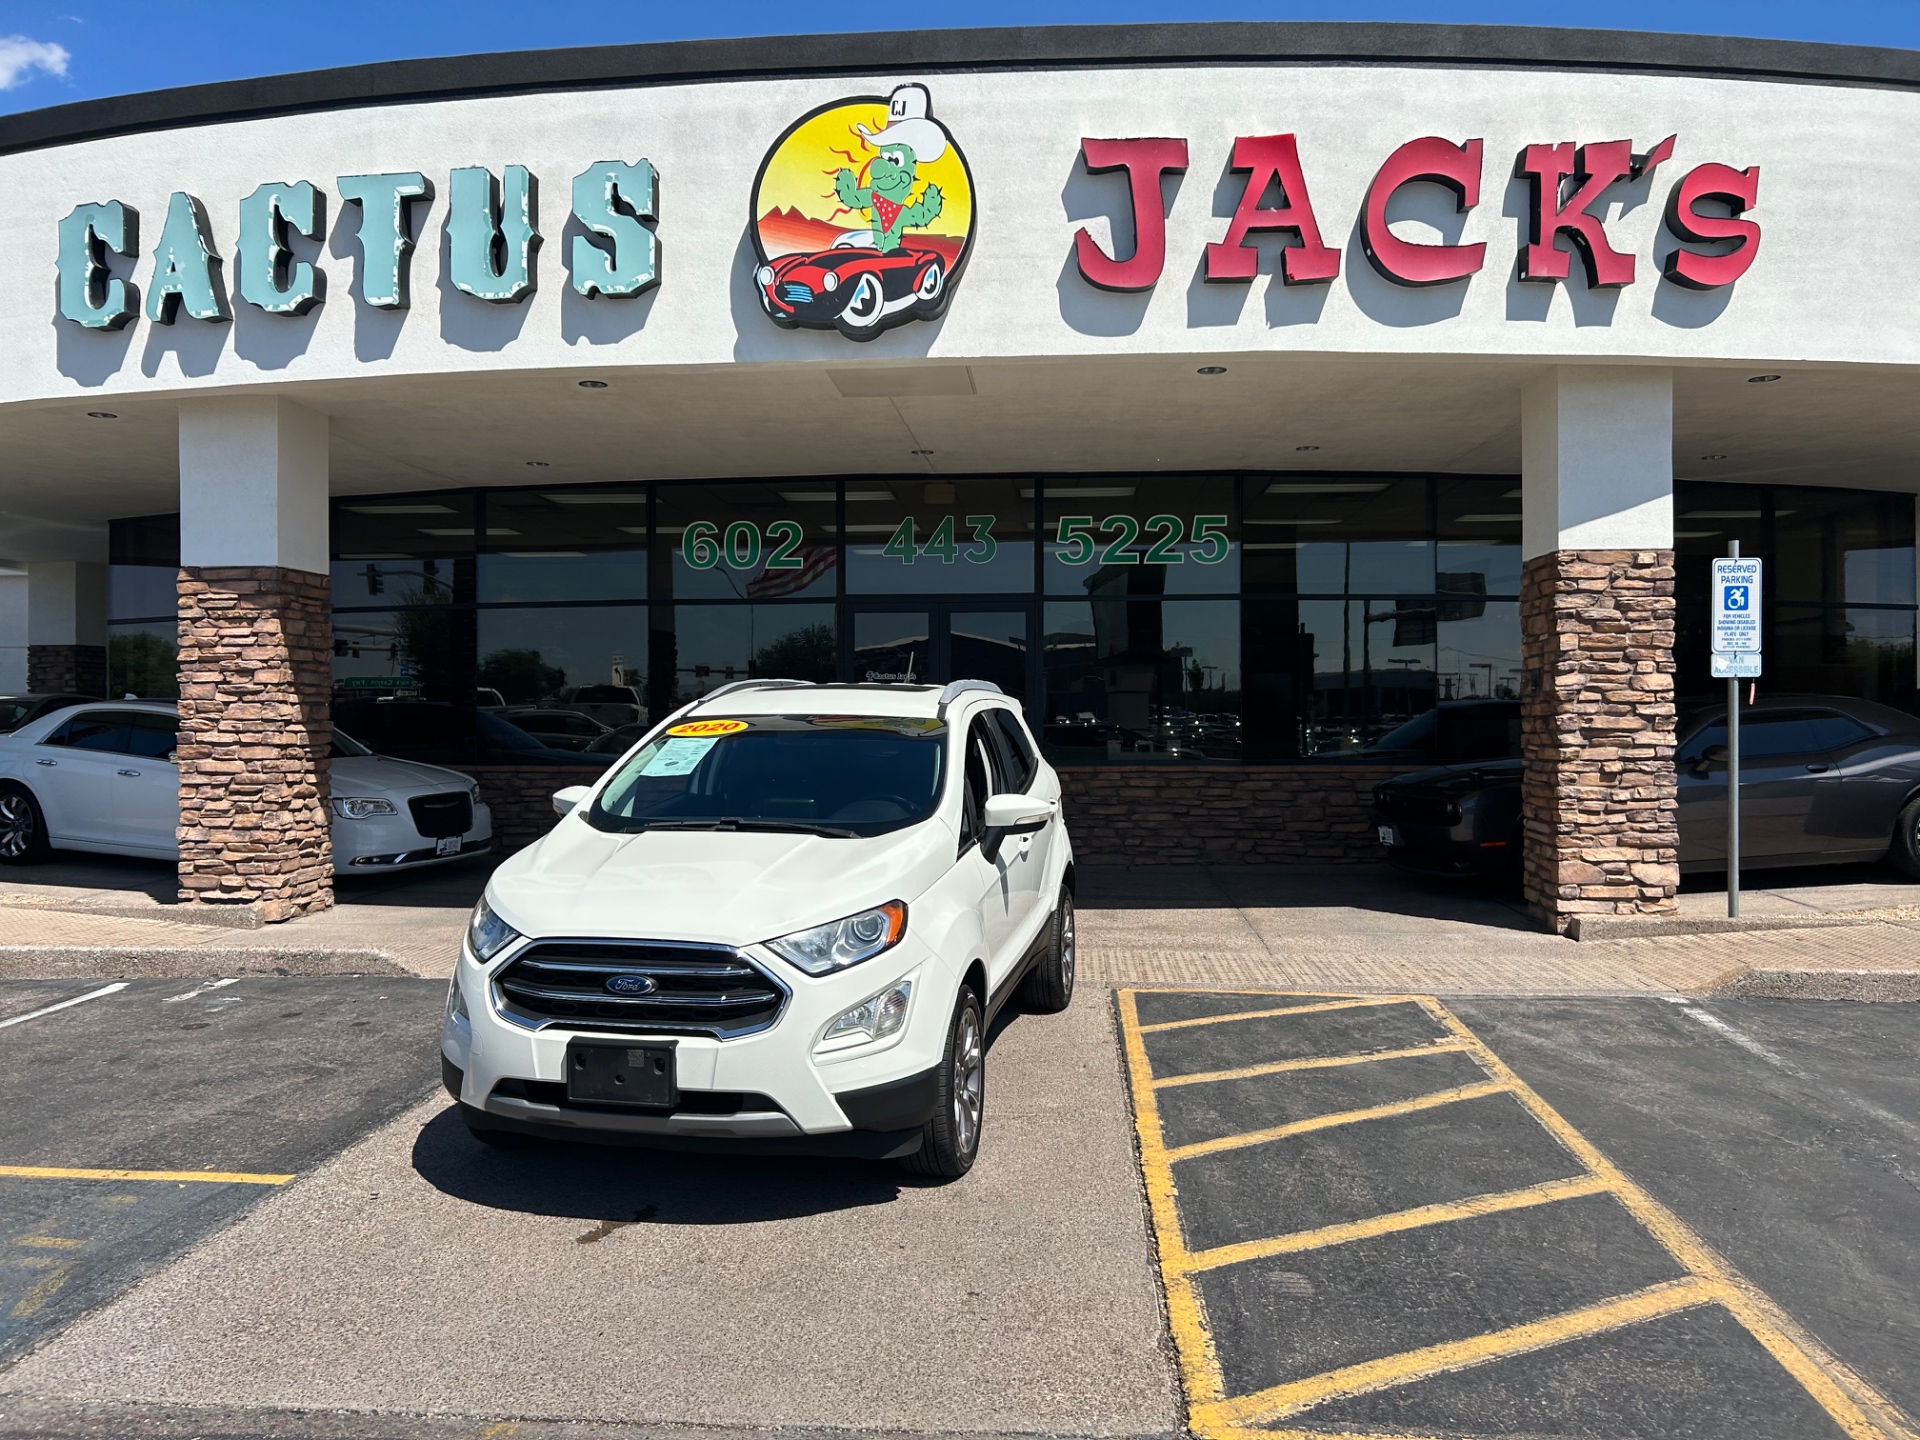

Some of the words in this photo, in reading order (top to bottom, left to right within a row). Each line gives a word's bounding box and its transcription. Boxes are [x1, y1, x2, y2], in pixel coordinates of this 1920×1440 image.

[891, 100, 907, 116] CJ
[55, 157, 662, 332] CACTUS
[682, 520, 804, 570] 602
[882, 515, 998, 565] 443
[1055, 514, 1230, 565] 5225
[1717, 564, 1757, 574] RESERVED
[1721, 575, 1754, 584] PARKING
[1728, 655, 1744, 664] VAN
[674, 722, 741, 734] 2020
[615, 978, 641, 991] Ford
